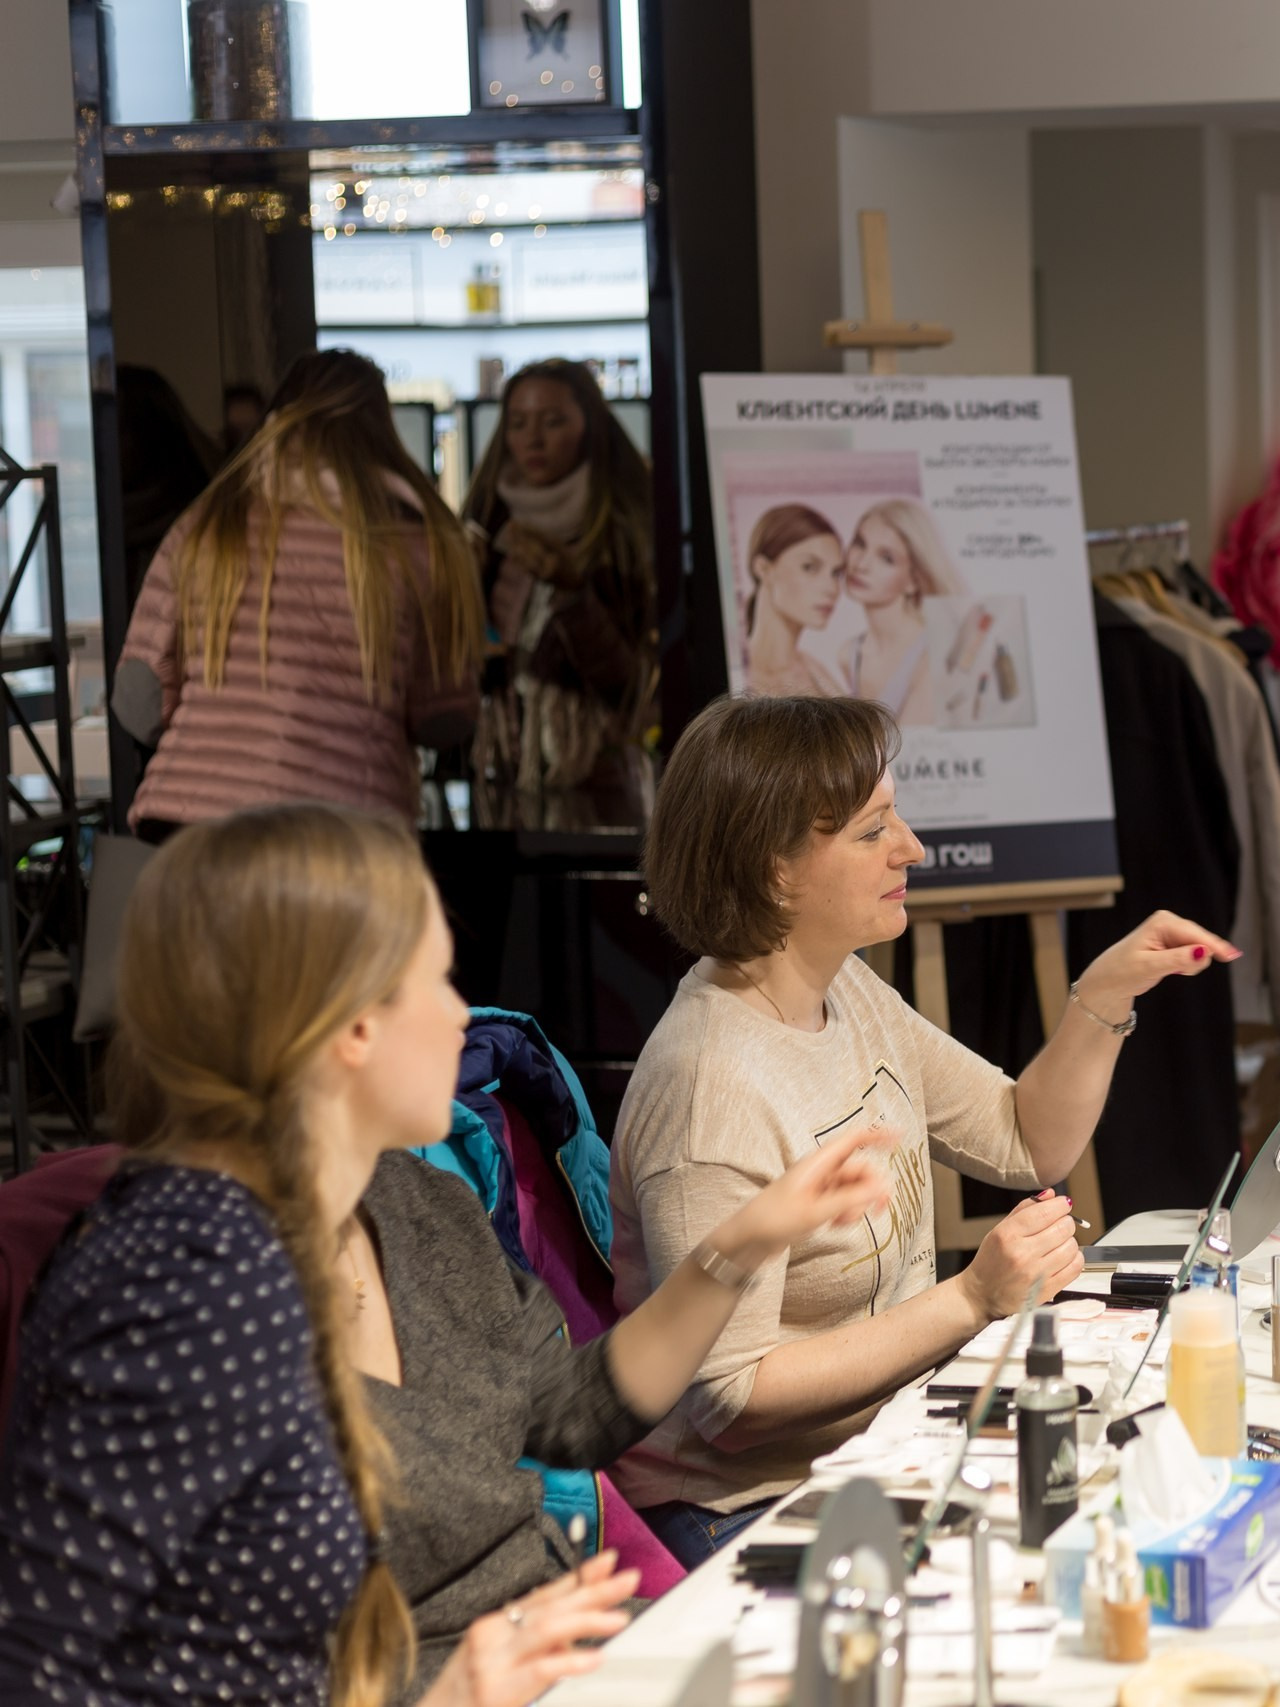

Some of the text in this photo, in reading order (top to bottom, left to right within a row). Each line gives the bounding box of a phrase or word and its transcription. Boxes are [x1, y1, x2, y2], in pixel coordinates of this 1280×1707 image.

[737, 396, 1042, 422] КЛИЕНТСКИЙ ДЕНЬ LUMENE
[896, 757, 986, 781] UMENE
